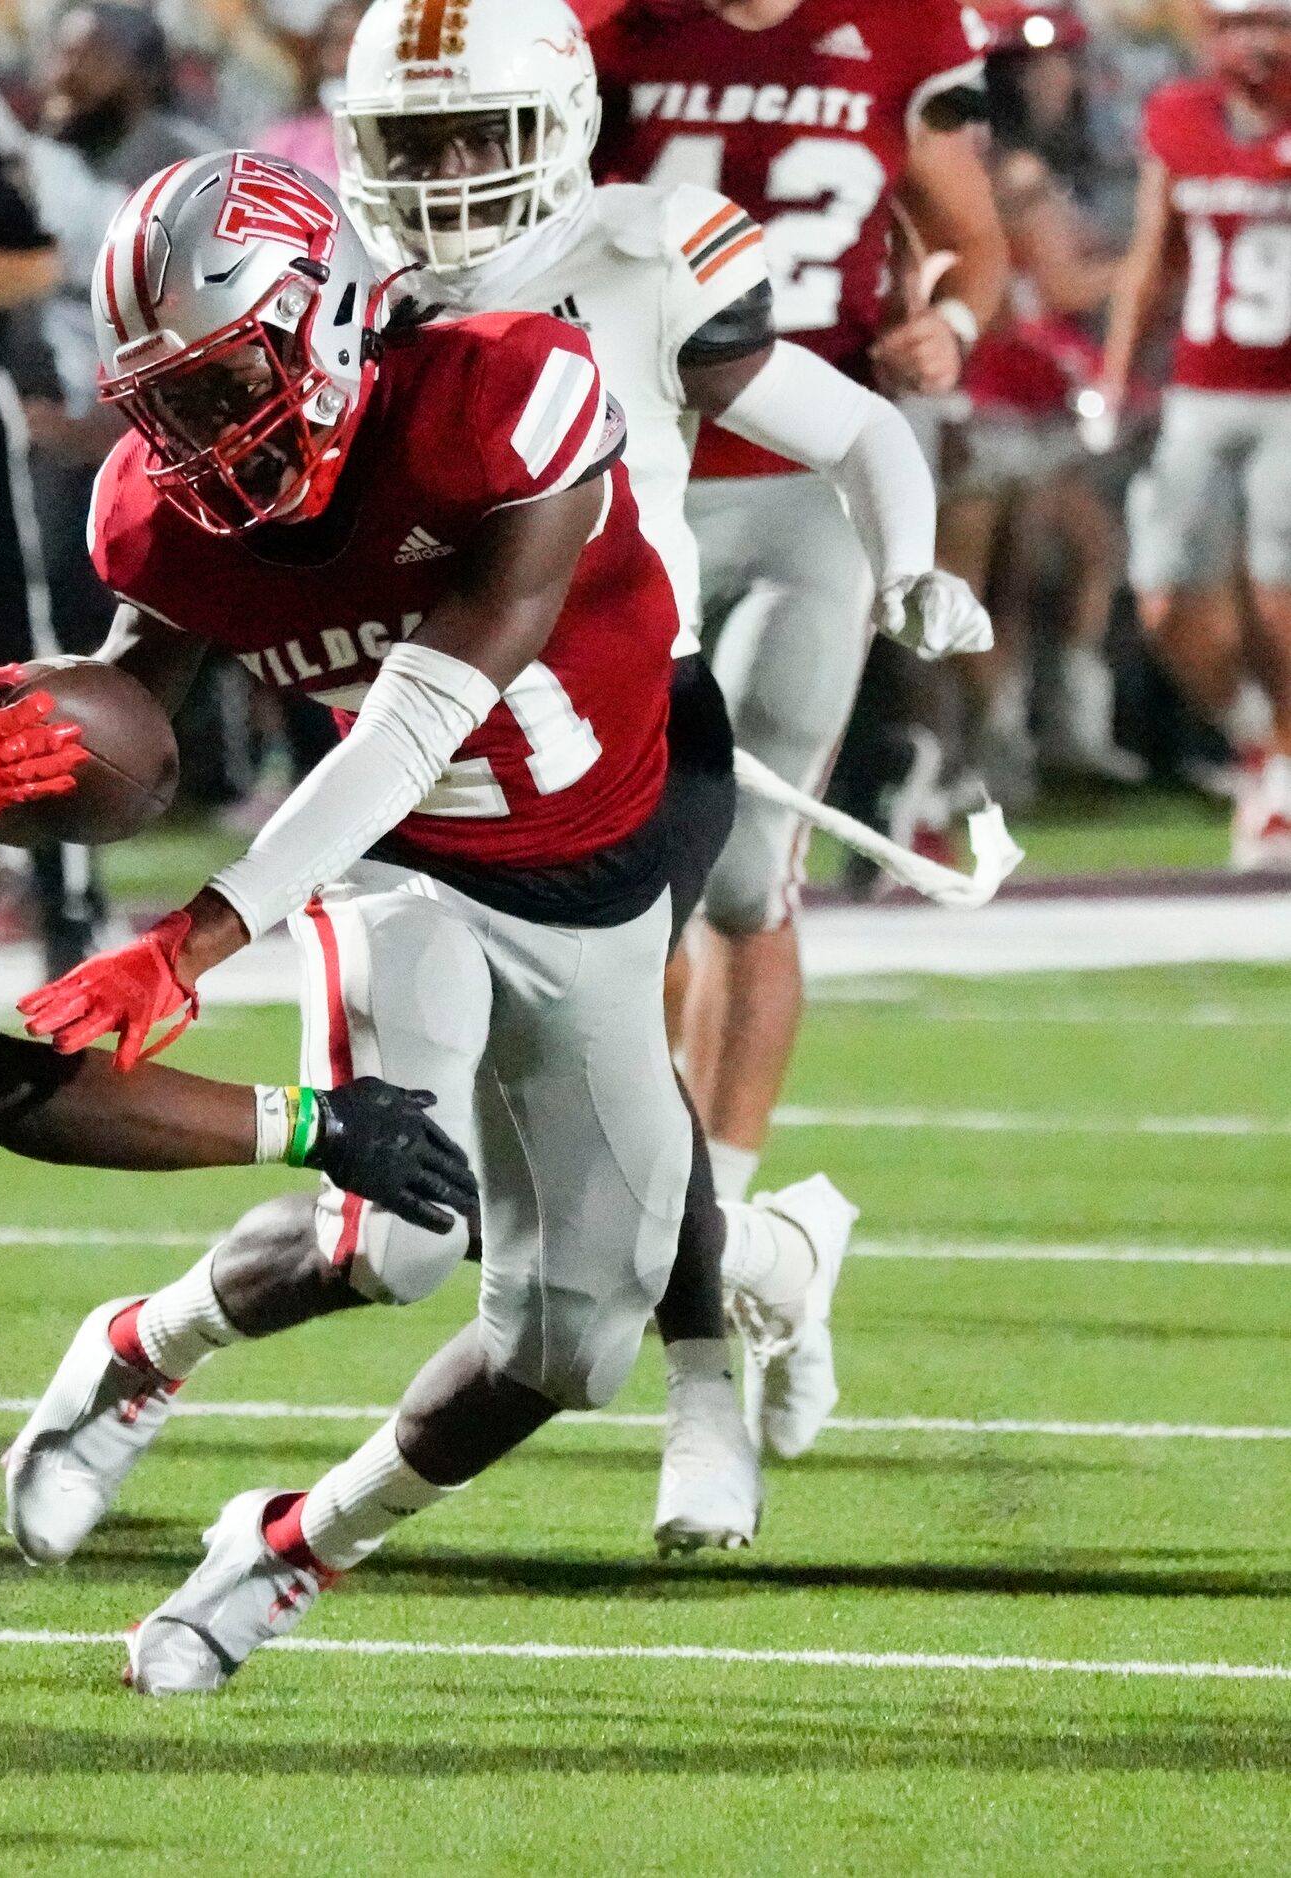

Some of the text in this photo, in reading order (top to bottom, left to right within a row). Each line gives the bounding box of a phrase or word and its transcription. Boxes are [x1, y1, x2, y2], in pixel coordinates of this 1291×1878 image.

[213, 153, 340, 262] W
[1182, 222, 1291, 346] 19
[394, 545, 456, 565] adidas
